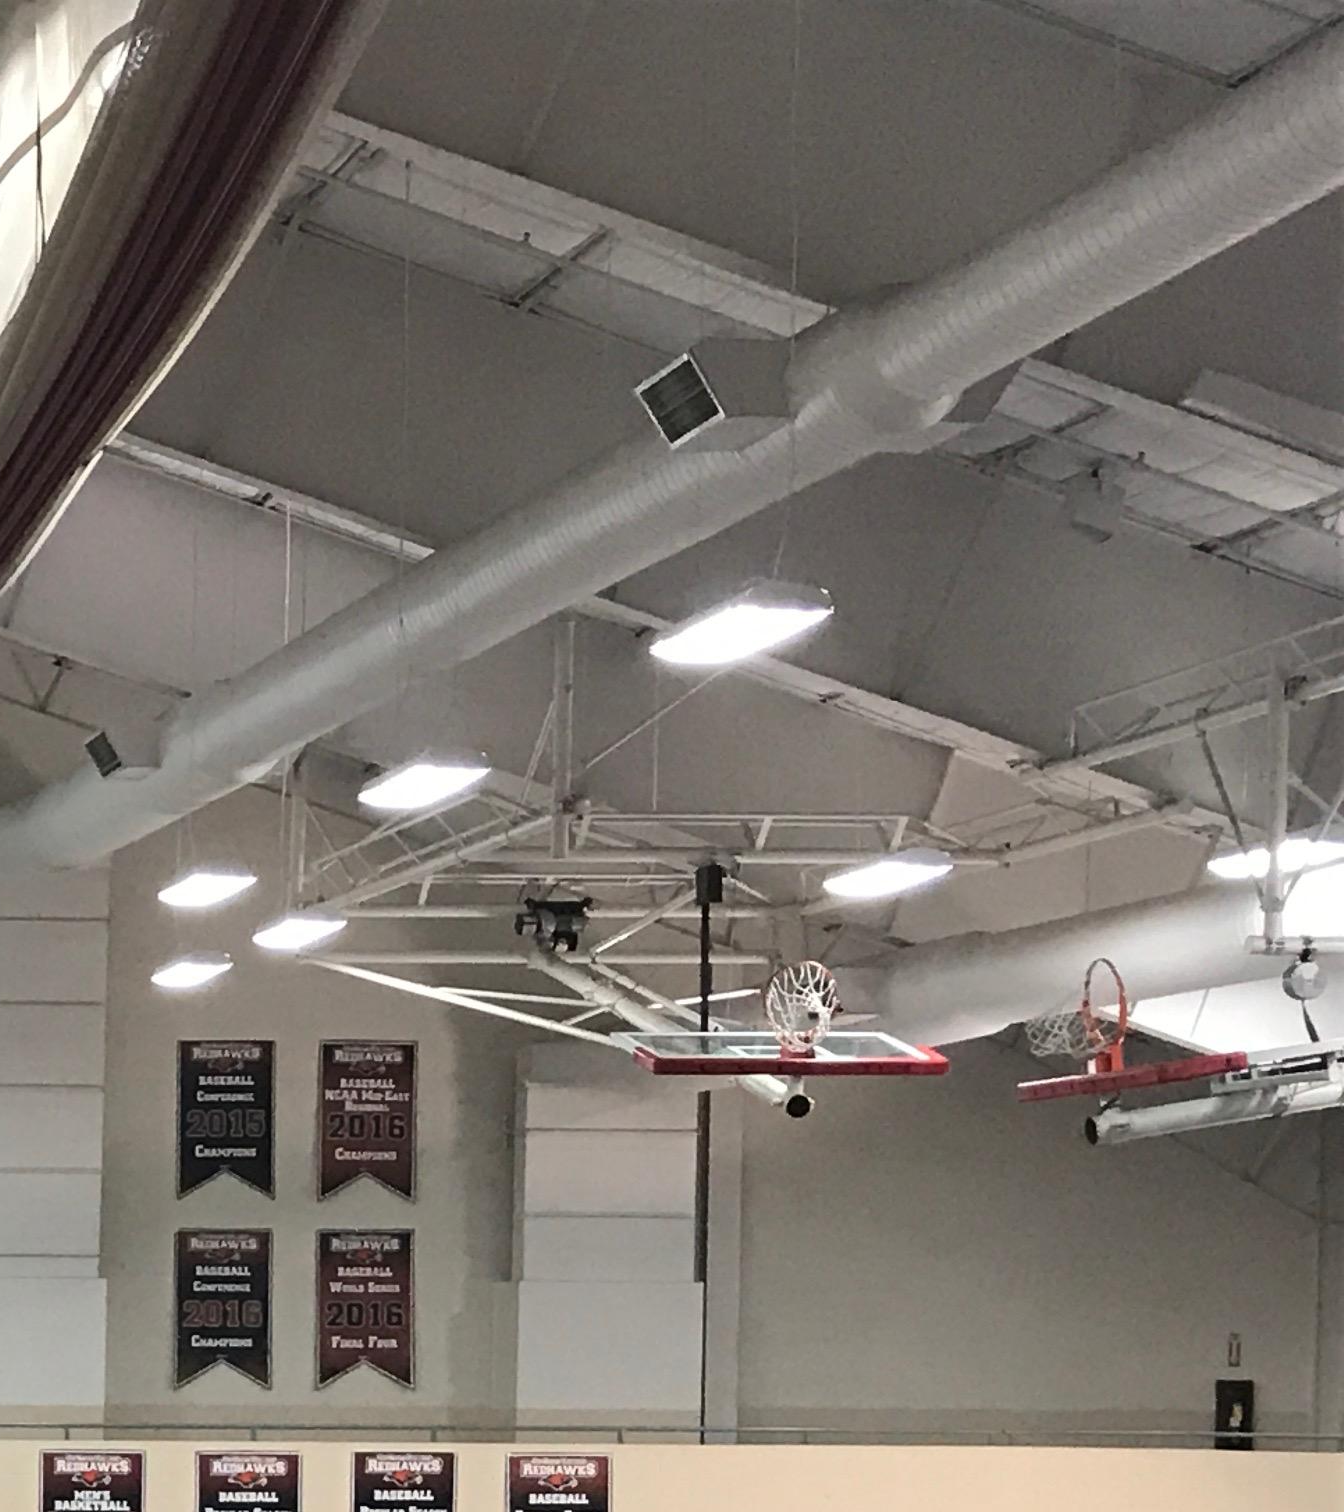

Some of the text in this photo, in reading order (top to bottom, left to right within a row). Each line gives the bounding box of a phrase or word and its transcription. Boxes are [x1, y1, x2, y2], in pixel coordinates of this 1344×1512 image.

[186, 1109, 267, 1137] 2015
[327, 1113, 406, 1140] 2016
[183, 1300, 264, 1327] 2016
[326, 1302, 404, 1328] 2016
[218, 1492, 278, 1502] BASEBALL
[373, 1490, 433, 1500] BASEBALL
[529, 1494, 588, 1504] BASEBALL
[55, 1501, 130, 1511] BASKETBALL
